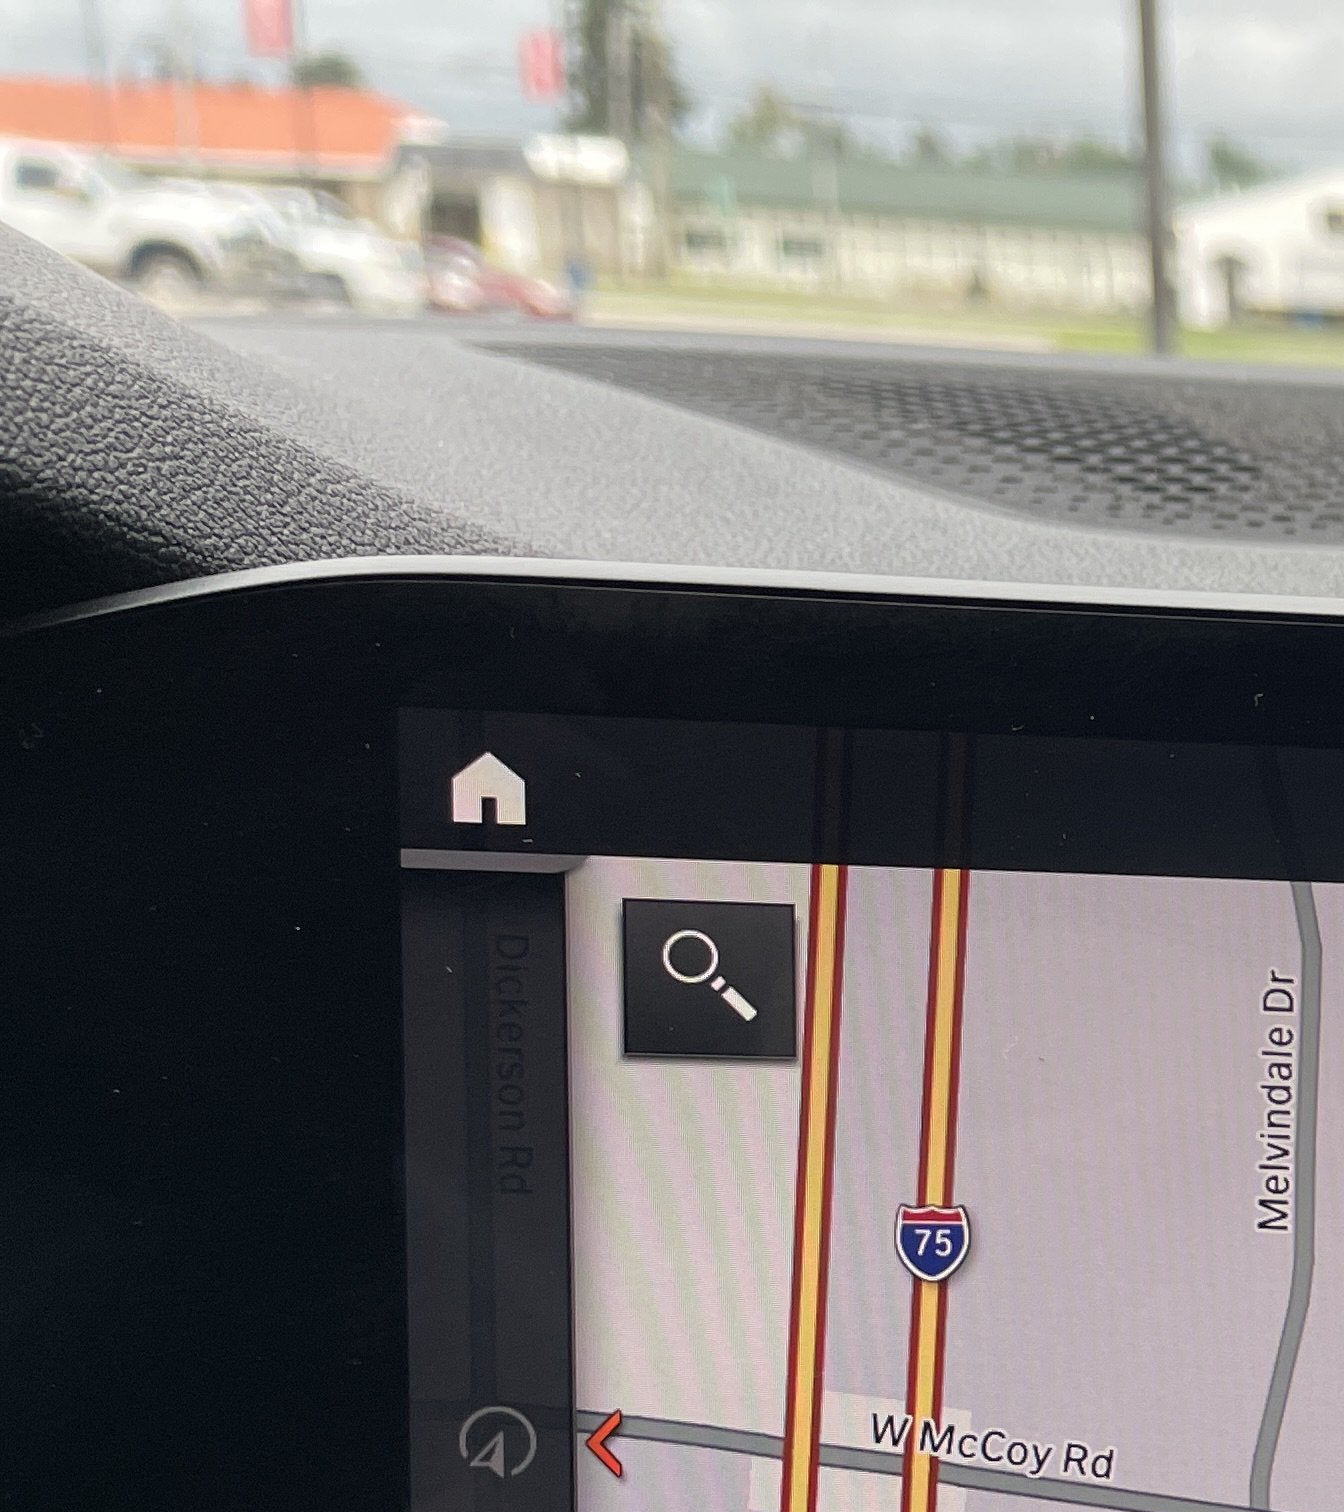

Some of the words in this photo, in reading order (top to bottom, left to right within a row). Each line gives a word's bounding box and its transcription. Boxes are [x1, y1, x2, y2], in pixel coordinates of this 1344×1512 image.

[1263, 970, 1295, 1014] Dr
[494, 933, 530, 1132] Dickerson
[1258, 1023, 1295, 1232] Melvindale
[498, 1144, 534, 1196] Rd
[915, 1230, 953, 1258] 75
[871, 1412, 910, 1447] W
[919, 1420, 1053, 1476] McCoy
[1062, 1442, 1114, 1480] Rd
